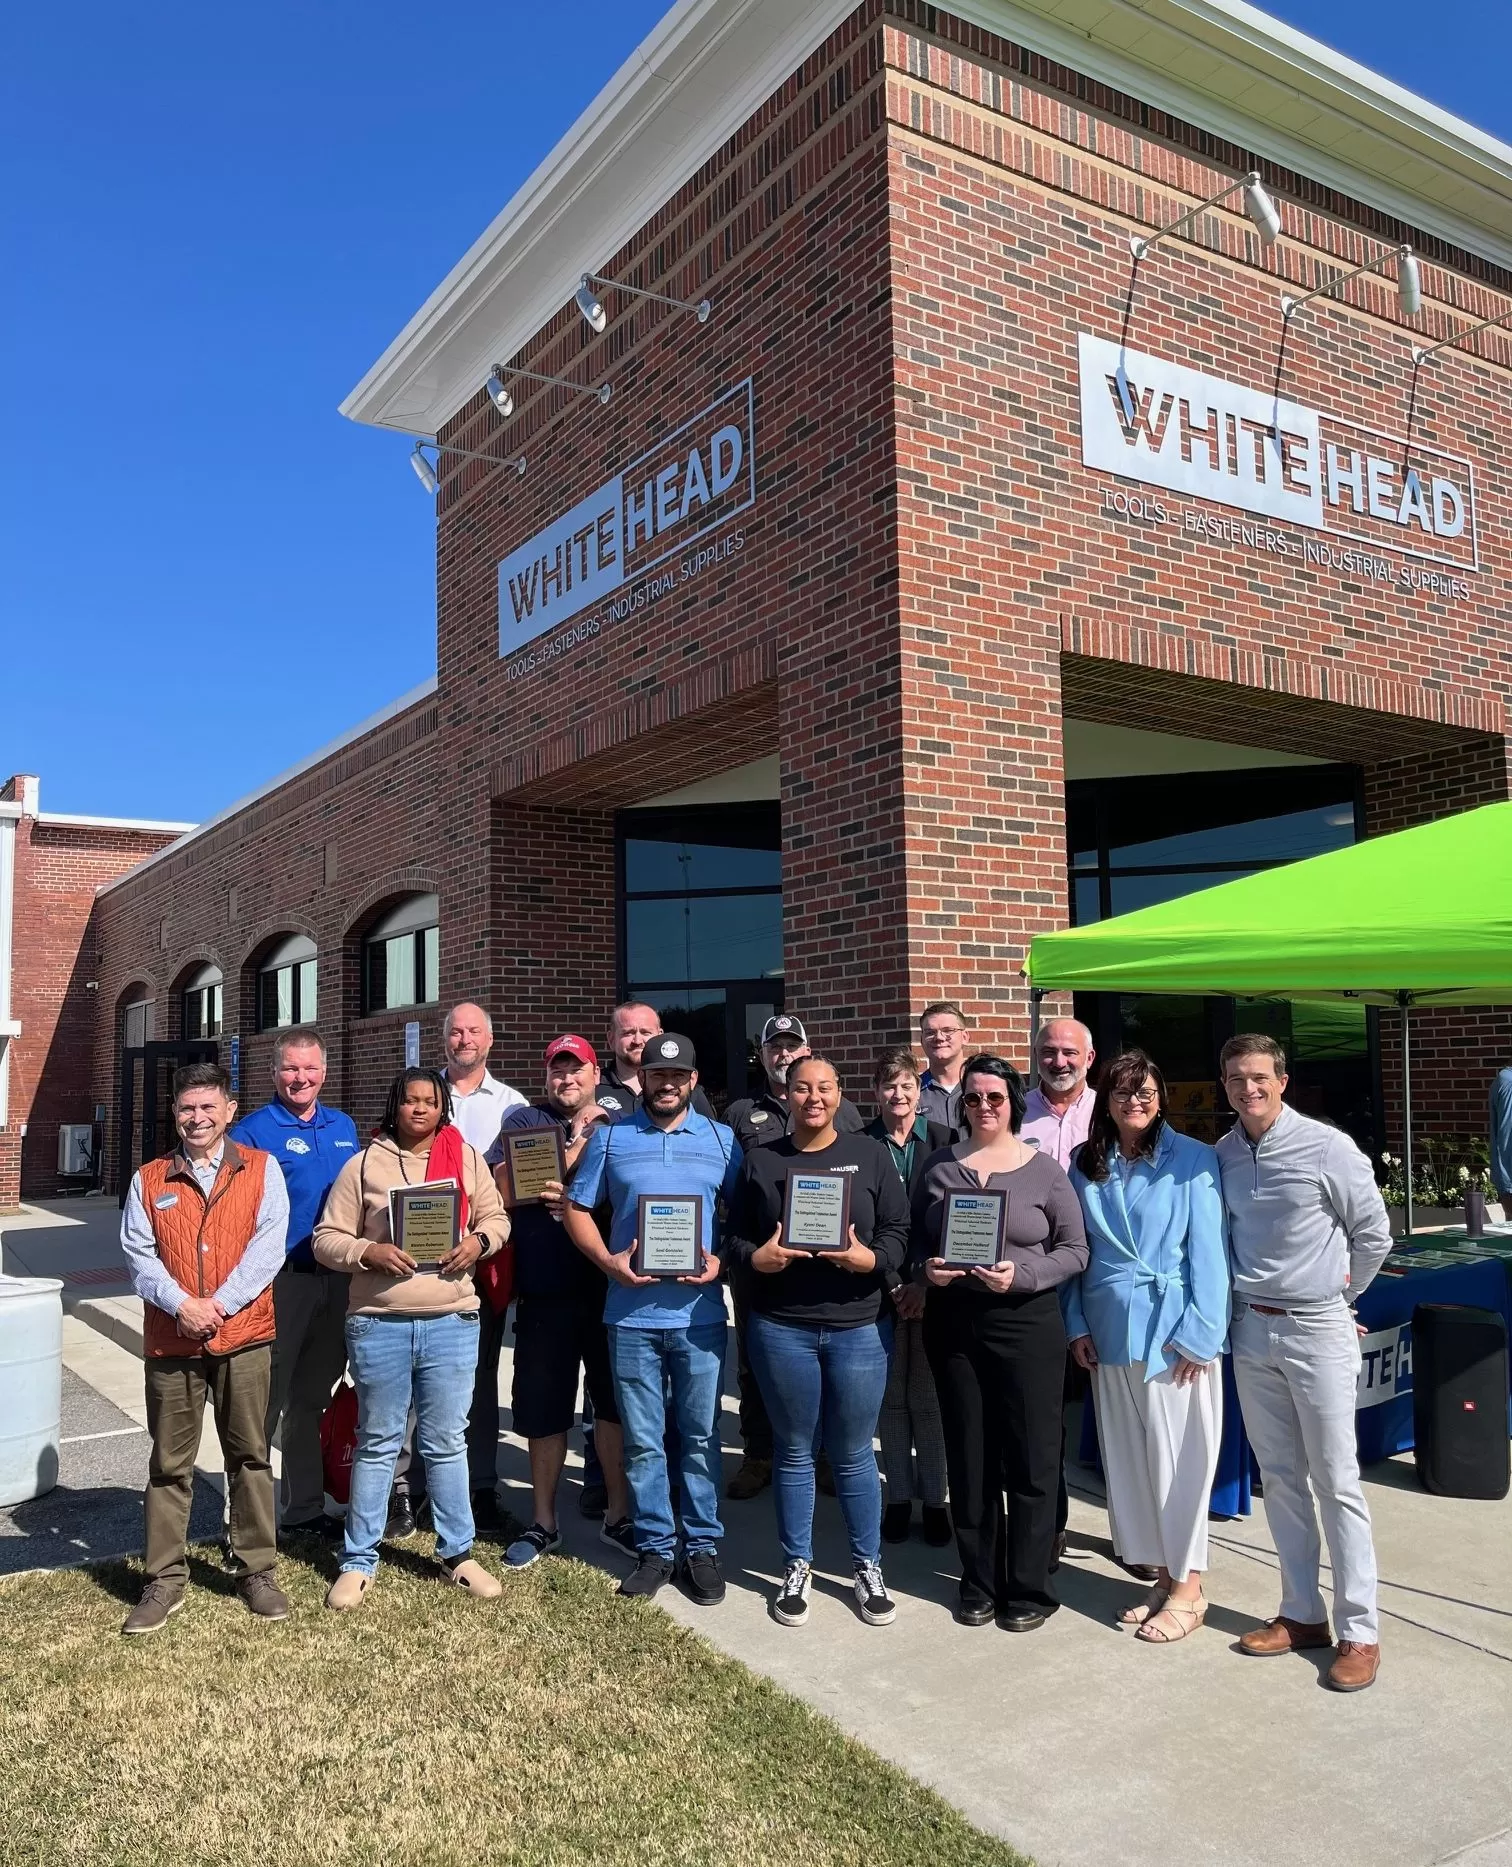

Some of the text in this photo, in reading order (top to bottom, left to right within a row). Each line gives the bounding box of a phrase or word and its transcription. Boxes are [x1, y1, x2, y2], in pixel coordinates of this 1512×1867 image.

[1105, 374, 1464, 538] WHITEHEAD
[508, 424, 744, 624] WHITEHEAD
[1100, 486, 1167, 524] TOOLS
[1184, 510, 1288, 556] FASTENERS
[1302, 540, 1398, 584] INDUSTRIAL
[1400, 567, 1470, 601] SUPPLIES
[505, 652, 536, 682] TOOLS
[542, 614, 600, 661] FASTENERS
[608, 570, 679, 624] INDUSTRIAL
[680, 528, 745, 582] SUPPLIES
[799, 1181, 837, 1190] WHITEHEAD
[829, 1164, 860, 1173] MAUSER
[410, 1202, 448, 1210] WHITEHEAD
[956, 1200, 994, 1208] WHITEHEAD
